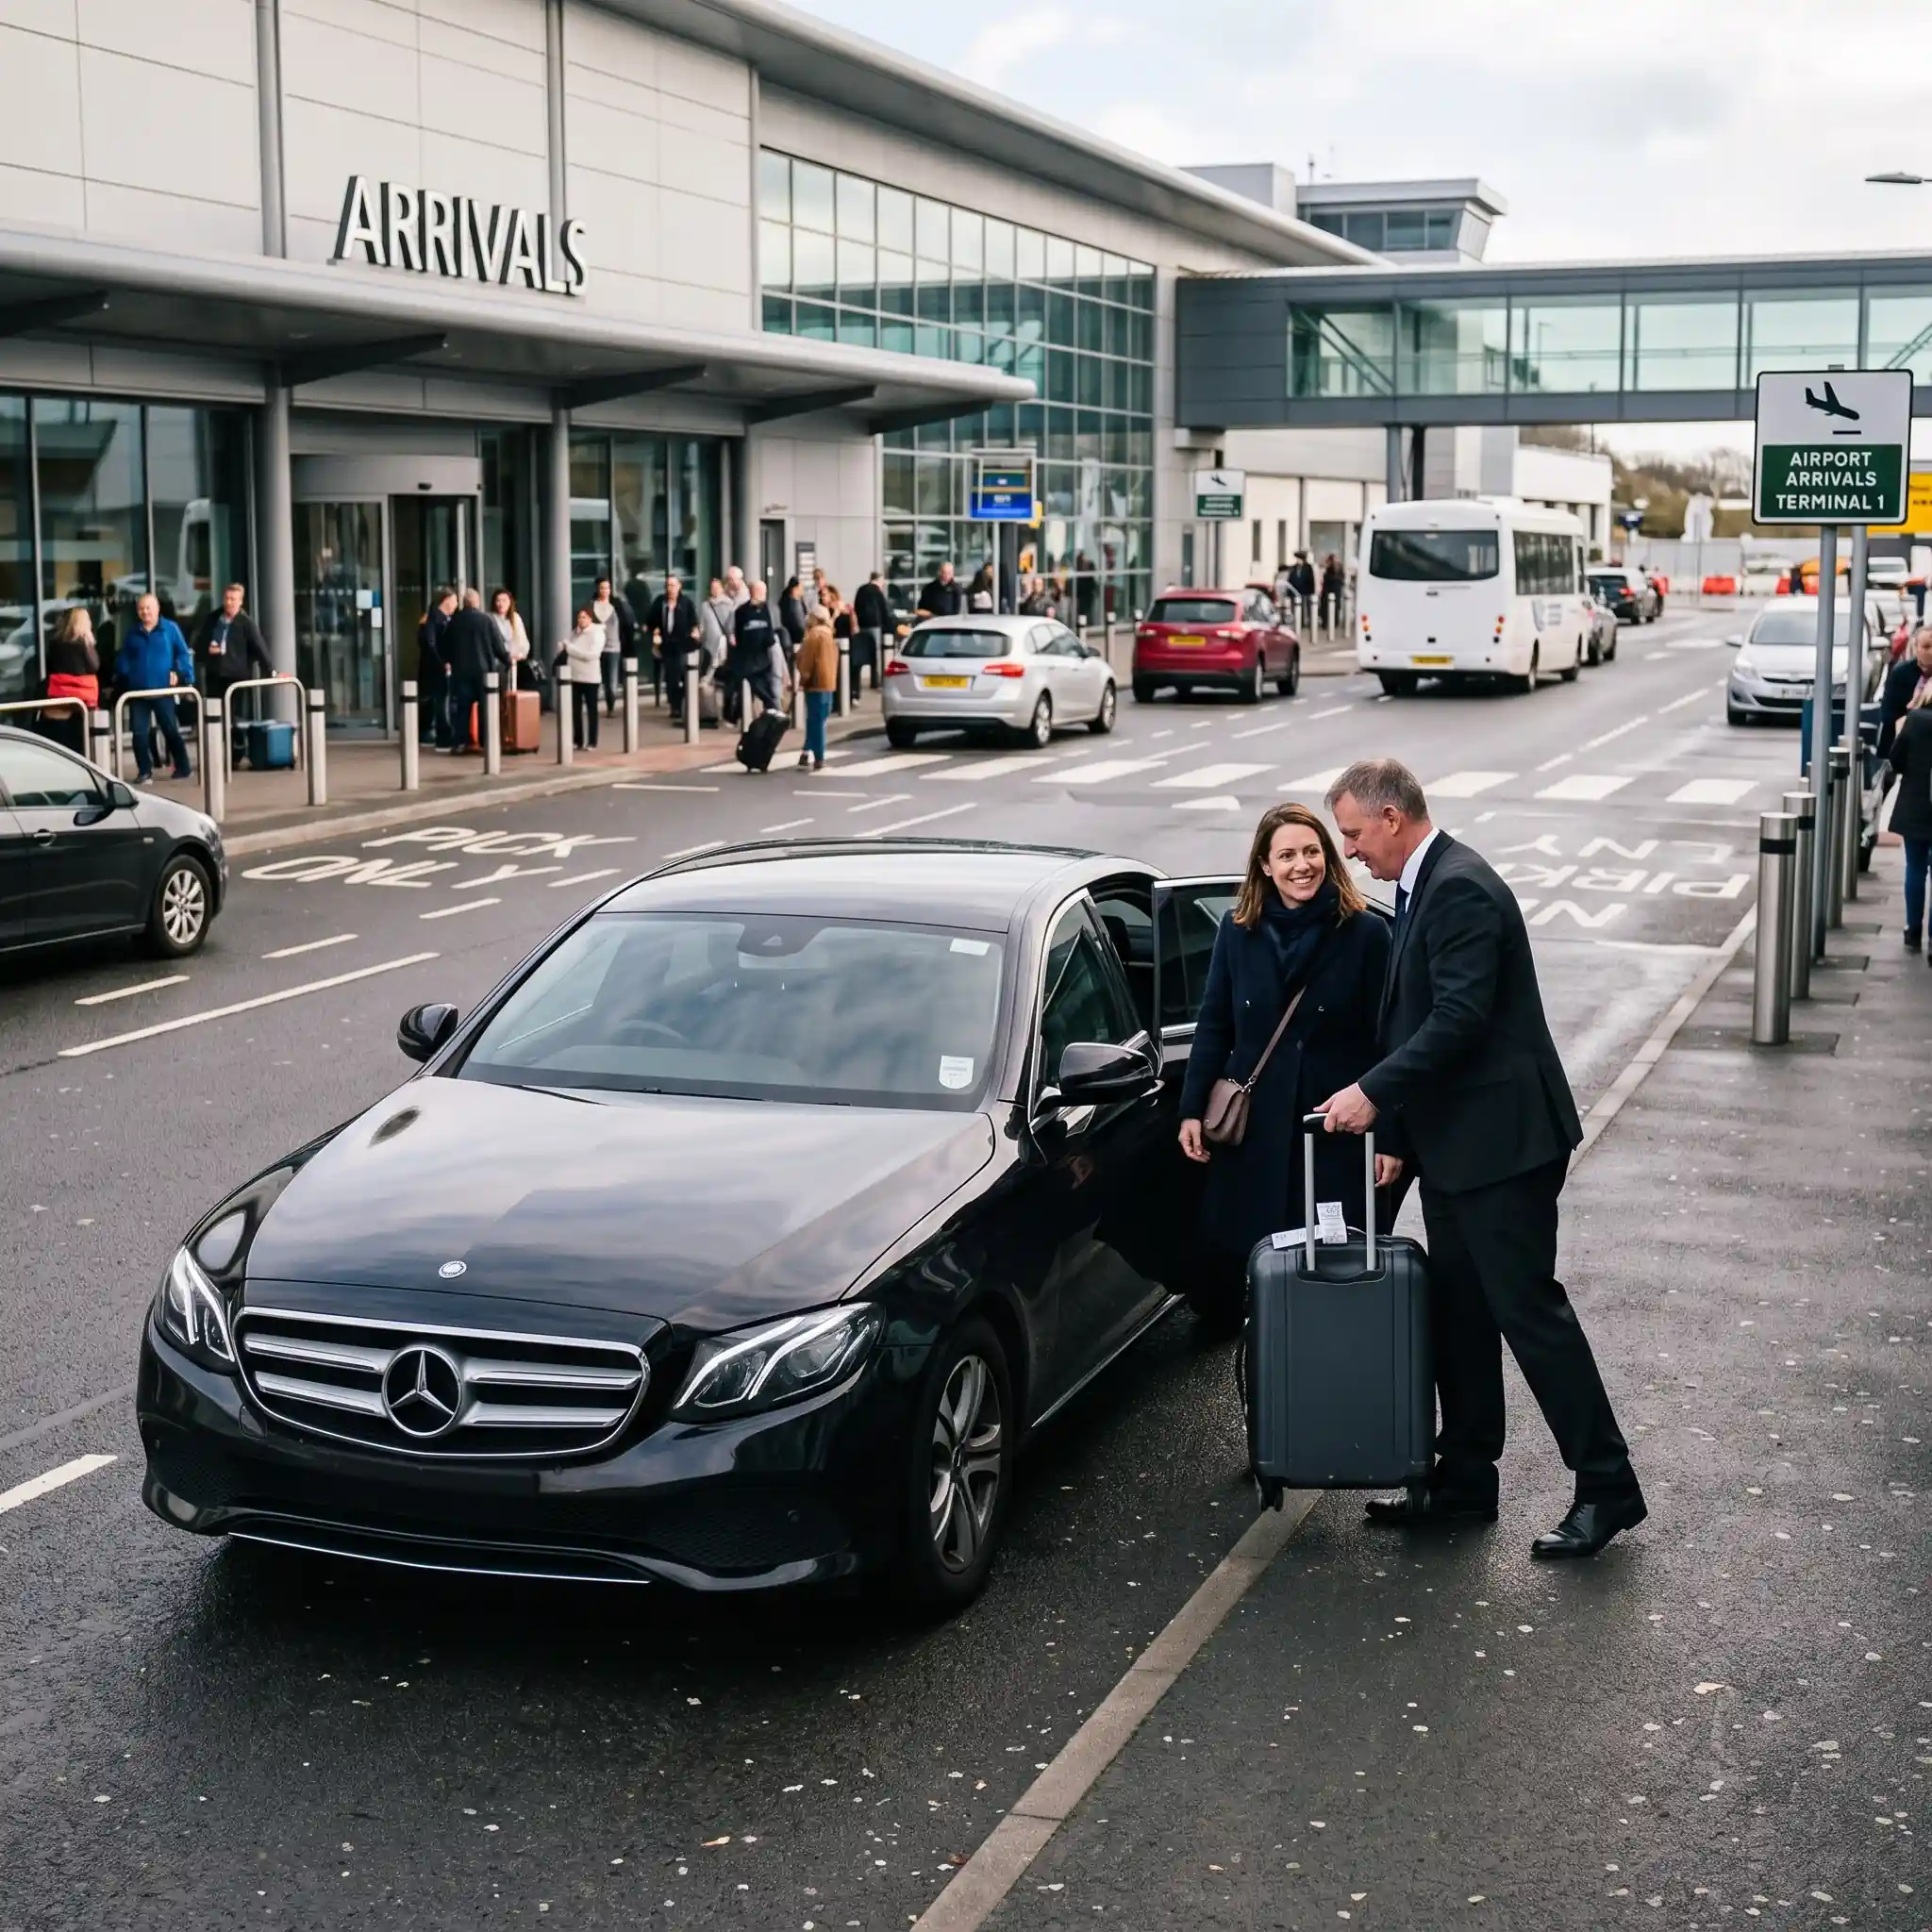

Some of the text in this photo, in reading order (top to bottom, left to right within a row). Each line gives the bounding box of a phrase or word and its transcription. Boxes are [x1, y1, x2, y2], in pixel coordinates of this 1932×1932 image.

[333, 174, 587, 296] ARRIVALS
[1790, 451, 1873, 467] AIRPORT
[1785, 471, 1877, 487] ARRIVALS
[1775, 493, 1885, 510] TERMINAL 1
[360, 826, 638, 858] PICK
[241, 855, 564, 890] ONLY
